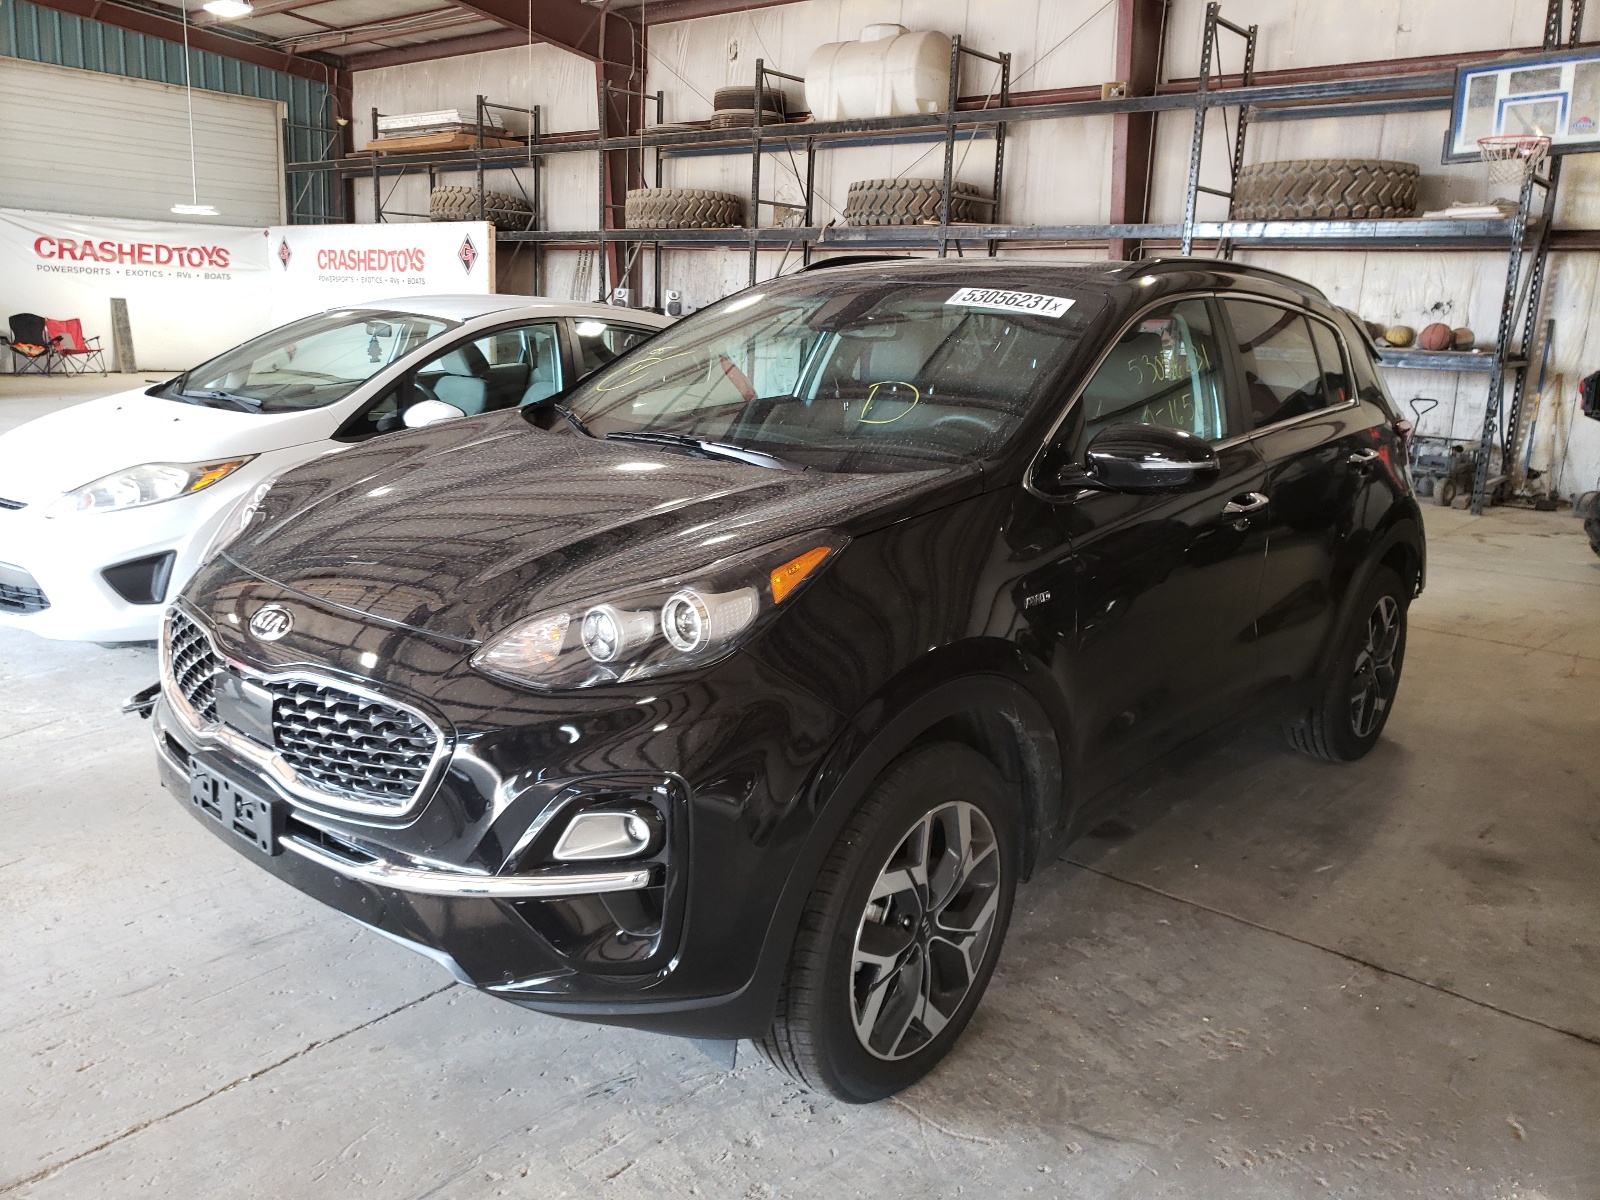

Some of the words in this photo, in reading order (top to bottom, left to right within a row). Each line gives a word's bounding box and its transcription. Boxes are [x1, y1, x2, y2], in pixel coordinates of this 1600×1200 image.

[33, 236, 230, 268] CRASHEDTOYS
[317, 247, 425, 272] CRASHEDTOYS
[36, 264, 111, 276] POWERSPORTS
[125, 269, 164, 278] EXOTICS
[176, 271, 192, 279] RVs
[204, 272, 232, 281] BOATS
[318, 275, 354, 283] POWERSPORTS
[361, 276, 383, 284] EXOTICS
[407, 277, 426, 285] BOATS
[251, 608, 289, 634] KIA
